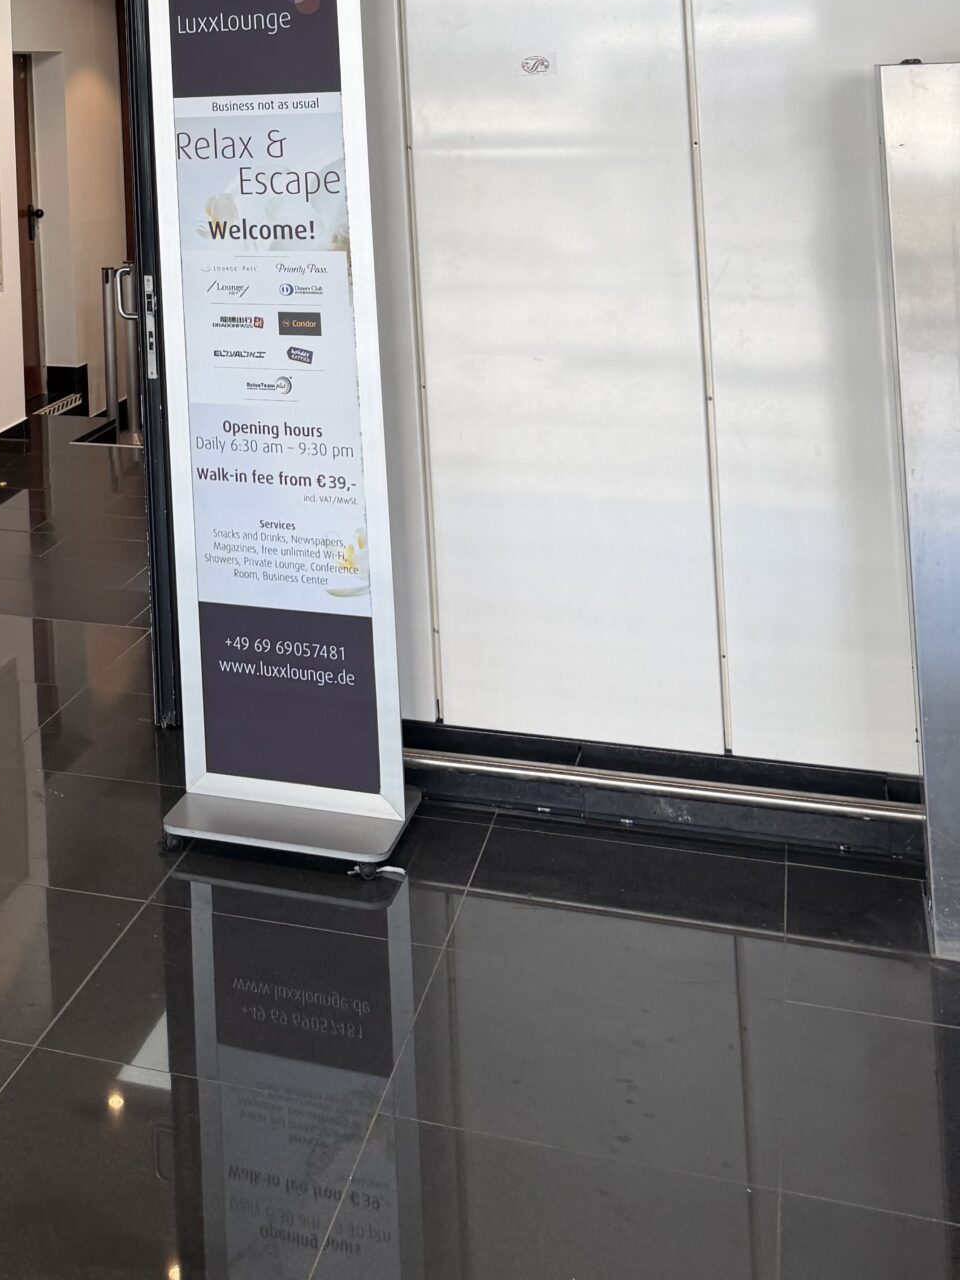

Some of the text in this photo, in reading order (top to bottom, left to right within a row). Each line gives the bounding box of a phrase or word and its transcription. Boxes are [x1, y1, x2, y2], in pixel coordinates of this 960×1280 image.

[178, 11, 291, 35] LuxxLounge
[212, 97, 320, 112] Business not as usual
[177, 128, 287, 160] Relax &
[239, 167, 340, 202] Escape
[208, 218, 315, 240] Welcome!
[275, 263, 306, 275] Priority
[292, 319, 316, 328] Condor
[223, 420, 323, 438] Opening hours
[196, 436, 226, 453] Daily
[230, 438, 258, 453] 6:30
[263, 442, 283, 454] am
[298, 442, 327, 456] 9:30
[332, 445, 354, 460] pm
[196, 467, 248, 483] Walk-in
[252, 470, 274, 485] fee
[279, 472, 312, 487] from
[259, 520, 296, 530] Services
[213, 528, 346, 549] Snacks and Drinks, Newspapers,
[213, 541, 258, 555] Magazines,
[261, 544, 278, 555] free
[280, 545, 321, 558] unlimited
[204, 553, 359, 575] Showers, Private Lounge, Conference
[233, 569, 329, 585] Room, Business Center
[225, 636, 345, 661] +49 69 69057481
[219, 660, 355, 686] www.luxxlounge.de
